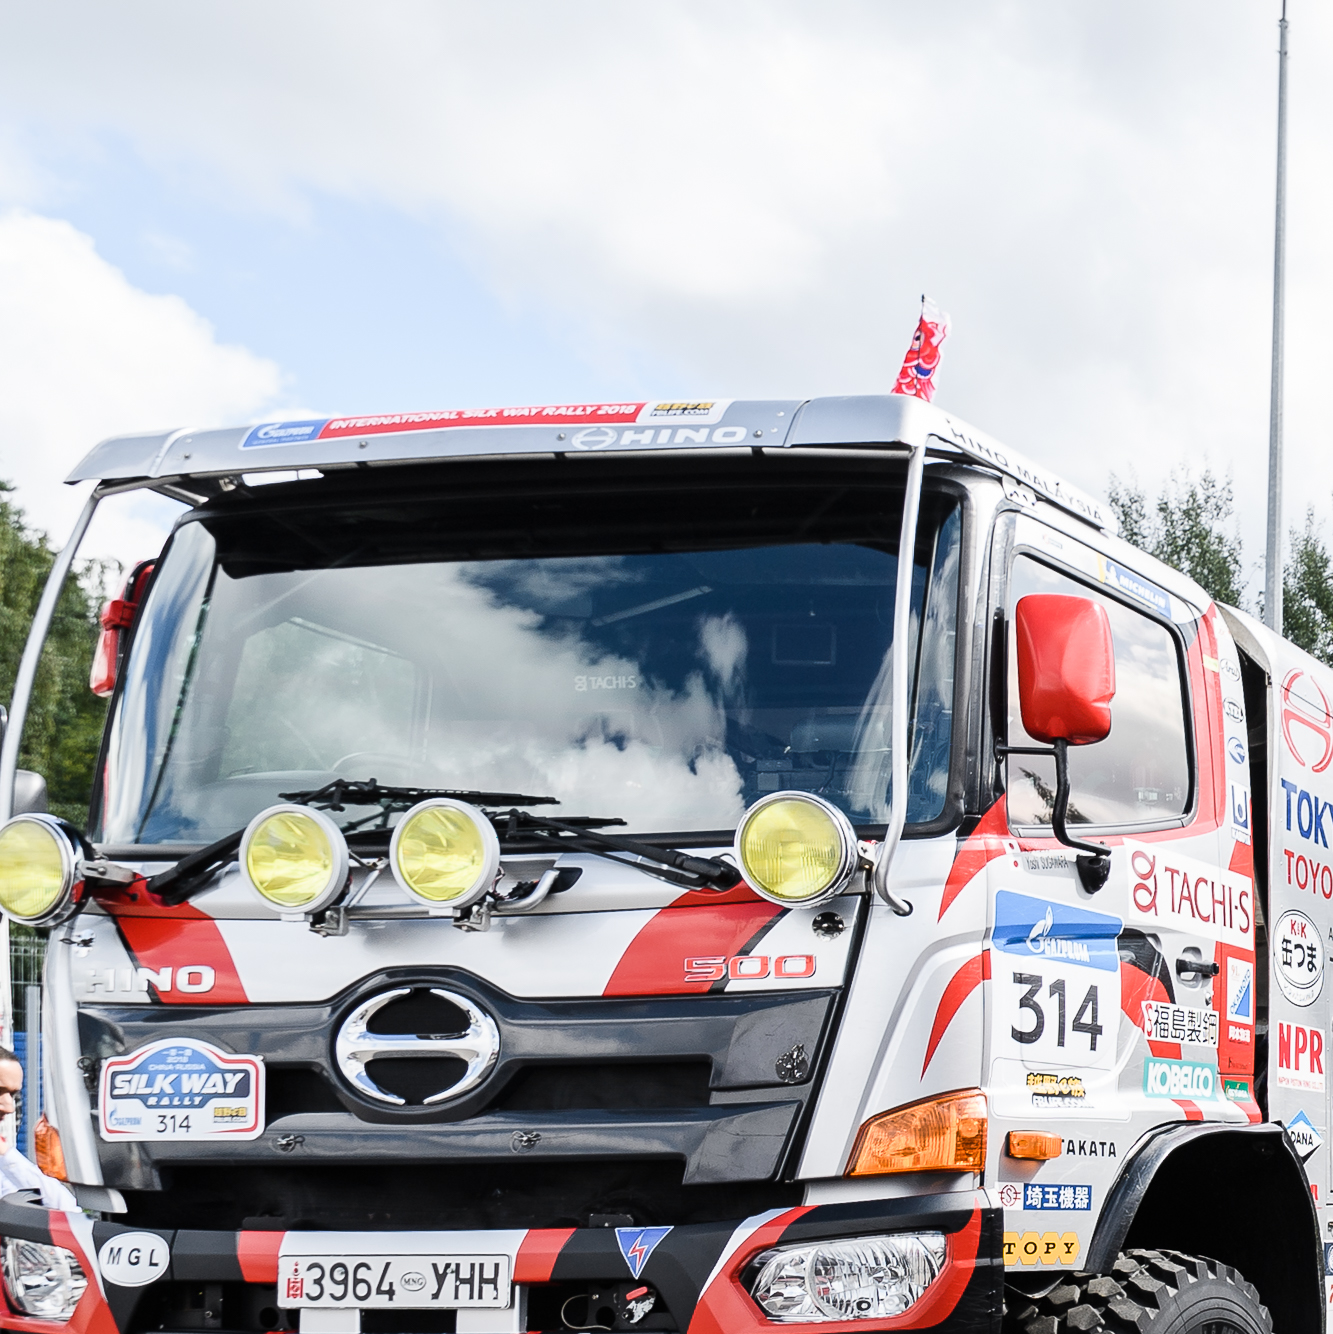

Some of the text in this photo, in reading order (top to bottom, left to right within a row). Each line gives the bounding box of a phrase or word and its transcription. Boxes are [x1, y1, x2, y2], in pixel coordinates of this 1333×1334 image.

[328, 404, 637, 430] INTERNATIONAL SILK WAY RALLY 2018
[619, 426, 748, 446] HINO
[1164, 866, 1250, 934] TACHI-S
[1281, 934, 1317, 974] 缶つま
[84, 964, 216, 994] HINO
[683, 954, 817, 984] 500
[1010, 971, 1104, 1052] 314
[1154, 1003, 1218, 1045] 福島製鋼
[1278, 1022, 1324, 1075] NPR
[112, 1072, 246, 1096] SILK WAY
[1148, 1062, 1214, 1098] KOBELCO
[146, 1096, 204, 1107] RALLY
[156, 1114, 192, 1133] 314
[1061, 1138, 1117, 1158] AKATA
[1291, 1131, 1314, 1147] DANA
[1025, 1185, 1090, 1210] 埼玉機器
[1003, 1241, 1075, 1255] TOPY
[306, 1263, 396, 1302] 3964
